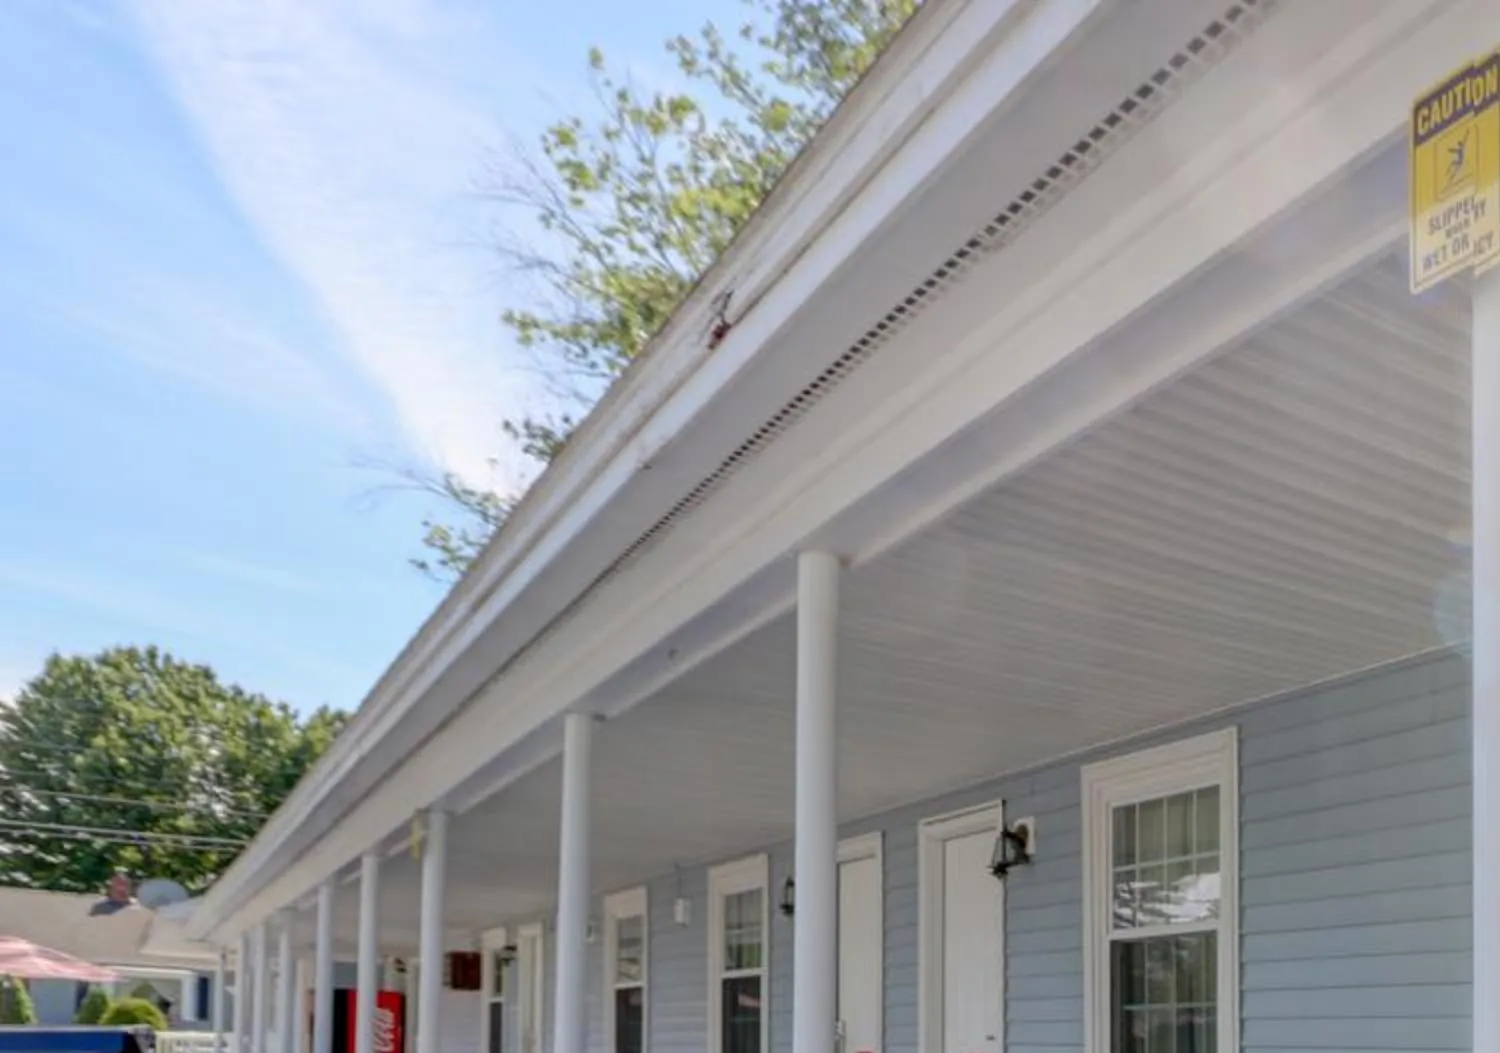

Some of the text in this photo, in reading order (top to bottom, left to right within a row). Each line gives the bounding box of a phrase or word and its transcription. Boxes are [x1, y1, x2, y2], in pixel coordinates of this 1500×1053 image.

[1416, 63, 1499, 136] CAUTION
[1427, 194, 1487, 235] SLIPPERY
[1451, 232, 1470, 256] OR
[1473, 229, 1494, 257] ICY
